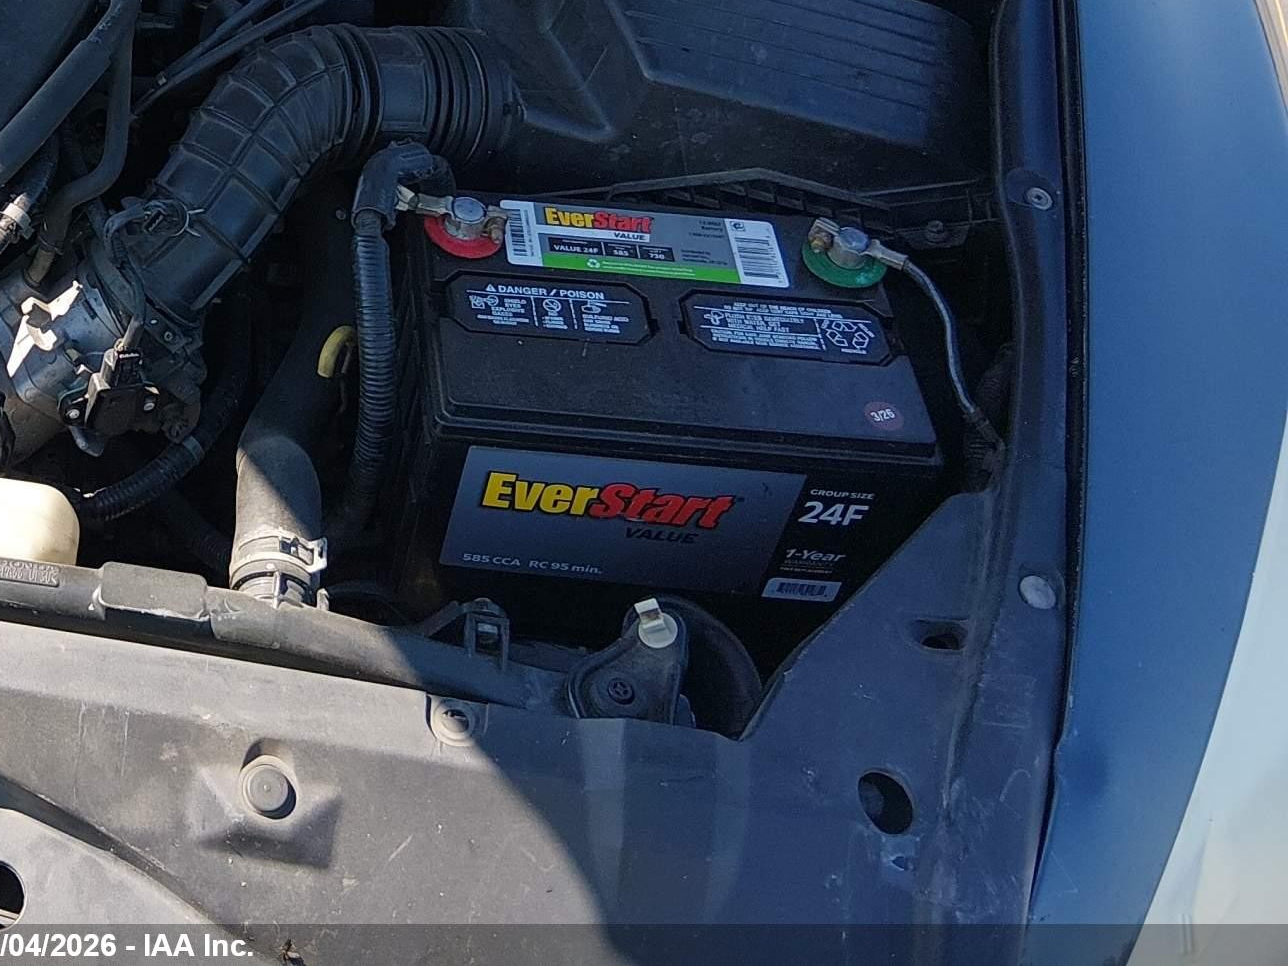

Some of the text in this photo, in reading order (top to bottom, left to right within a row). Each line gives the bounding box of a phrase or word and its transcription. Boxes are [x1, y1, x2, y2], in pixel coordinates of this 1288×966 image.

[544, 207, 654, 233] EverStart
[614, 232, 646, 241] VALUE
[553, 244, 581, 253] VALUE
[498, 285, 547, 295] DANGER
[560, 289, 605, 300] POISON
[870, 408, 896, 422] 3/26
[481, 470, 736, 530] EverStart
[810, 488, 875, 500] GROUP SIZE
[798, 501, 870, 526] 24F
[625, 526, 699, 545] VALUE
[785, 548, 846, 562] 1-Year
[462, 552, 603, 575] 585 CCA RC 95 min.
